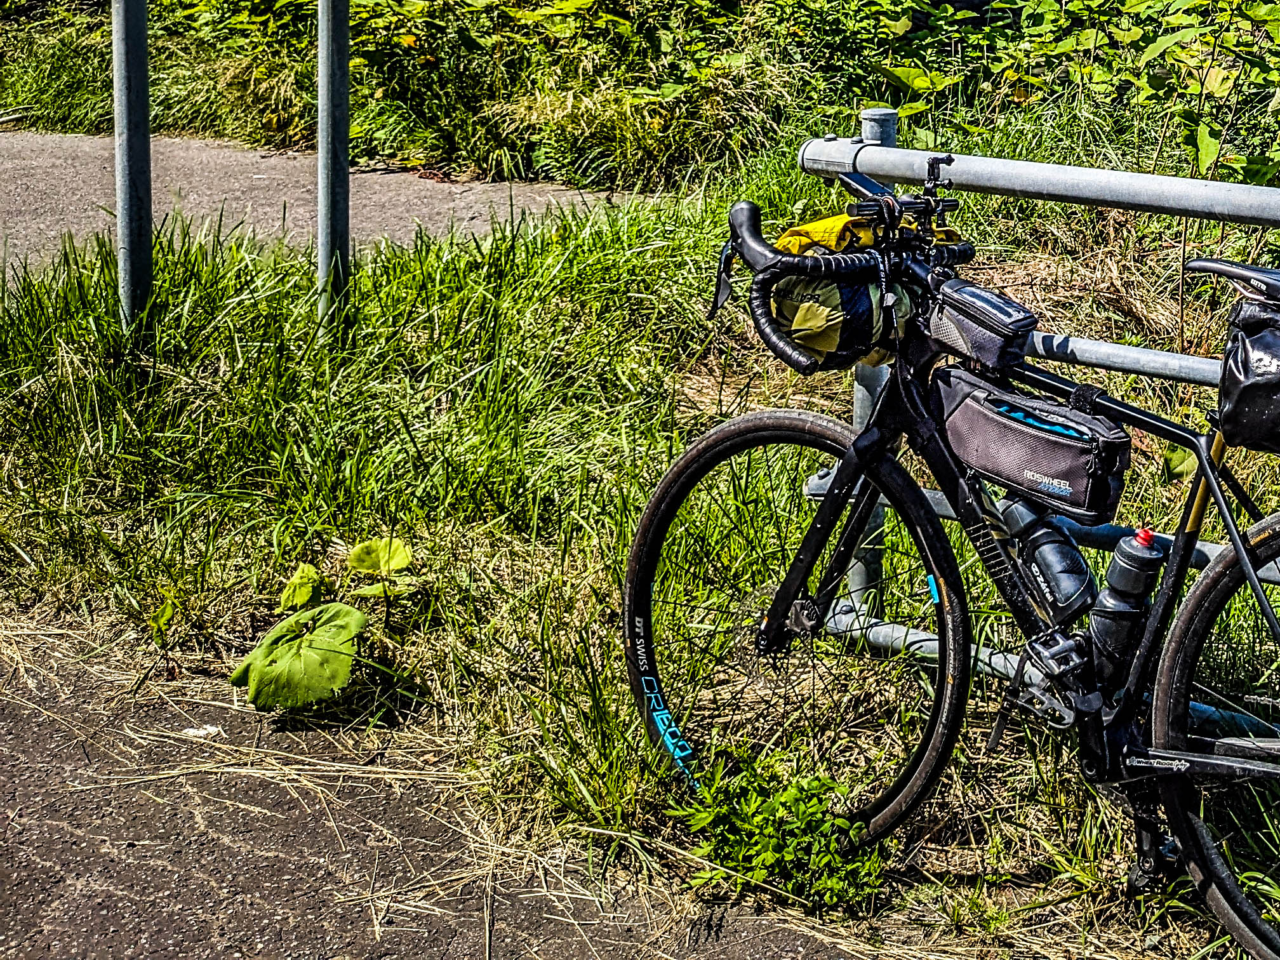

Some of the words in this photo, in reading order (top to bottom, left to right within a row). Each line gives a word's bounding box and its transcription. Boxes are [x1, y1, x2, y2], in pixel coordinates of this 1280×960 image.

[1024, 470, 1073, 489] ROSWHEEL
[635, 616, 644, 636] DT
[636, 638, 649, 671] SWISS
